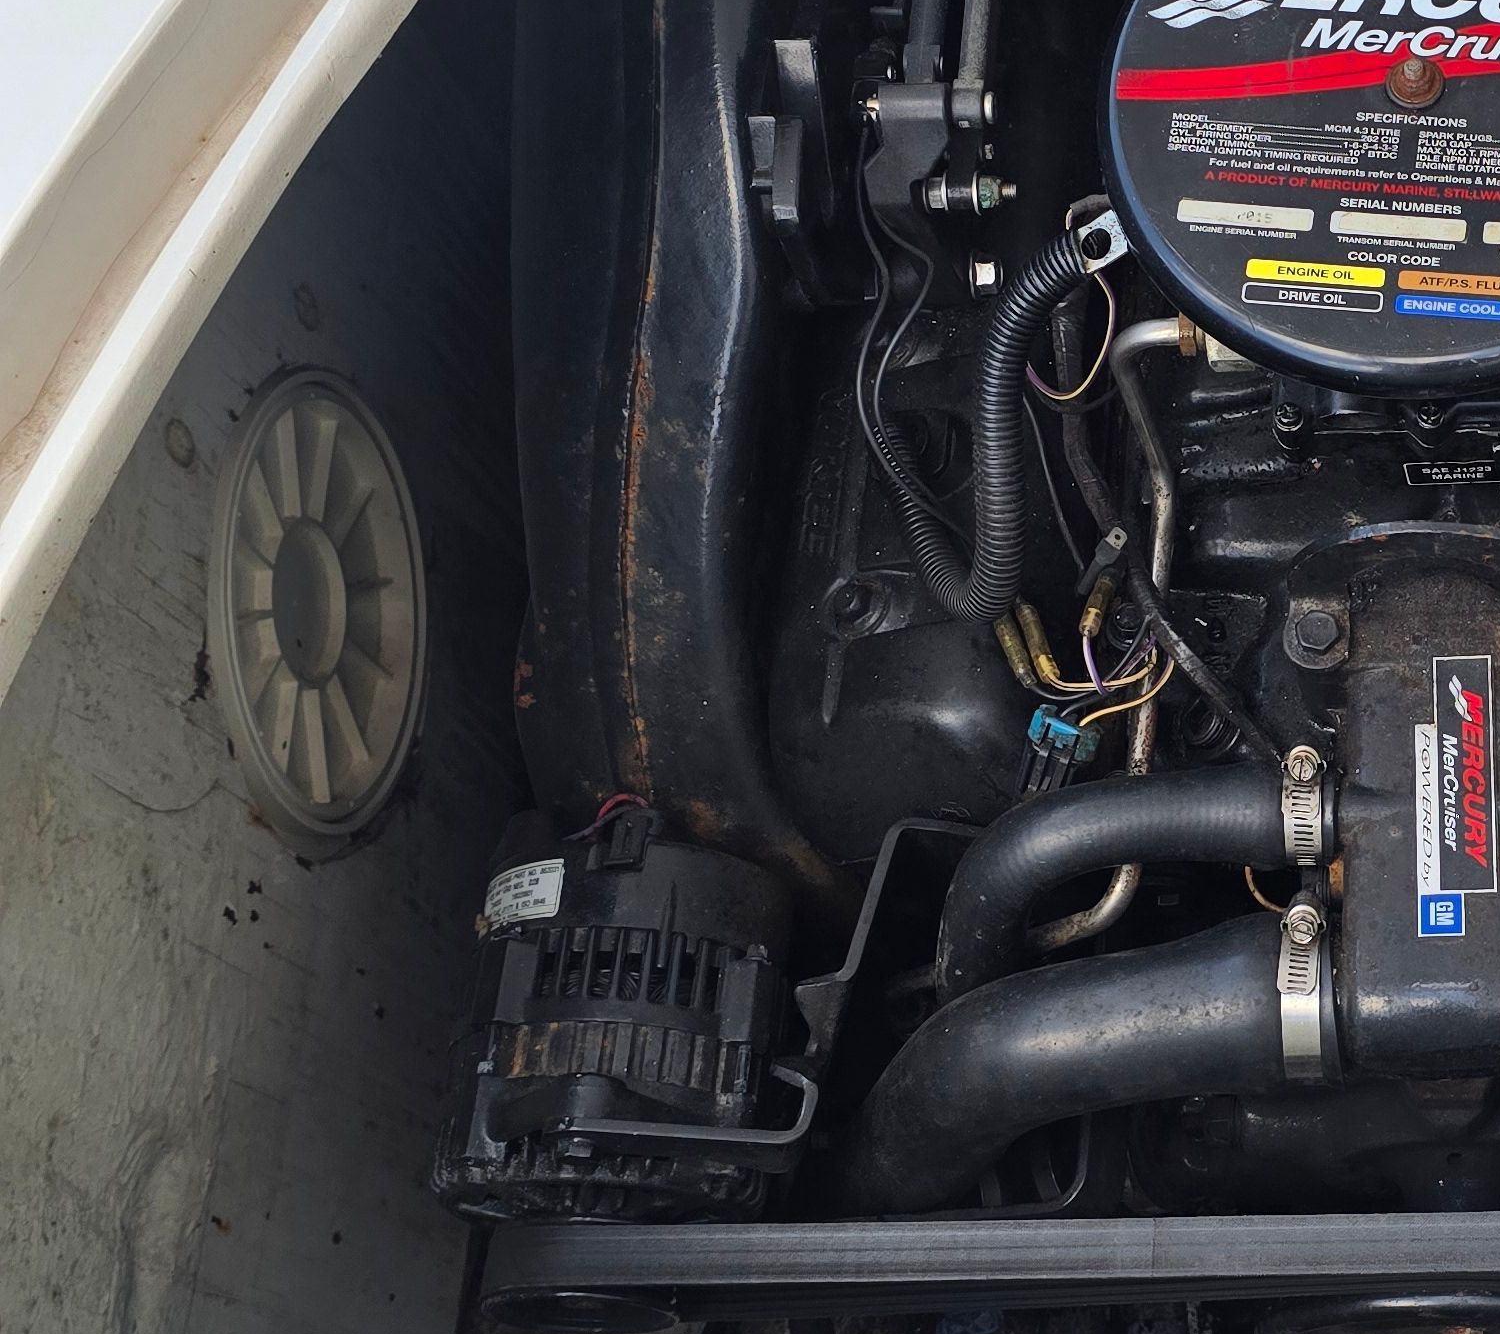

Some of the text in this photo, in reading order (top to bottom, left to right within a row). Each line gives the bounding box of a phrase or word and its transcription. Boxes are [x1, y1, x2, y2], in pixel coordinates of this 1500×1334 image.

[1173, 113, 1400, 136] MODEL MCM 4.3 LITRE
[1356, 112, 1467, 127] SPECIFICATIONS
[1171, 121, 1253, 133] DISPLACEMENT
[1381, 136, 1399, 144] CID
[1197, 130, 1230, 139] FIRING
[1233, 133, 1272, 142] ORDER
[1419, 131, 1453, 140] SPARK
[1456, 133, 1492, 142] PLUGS
[1169, 136, 1218, 146] IGNITION
[1220, 140, 1255, 148] TIMING
[1368, 151, 1398, 159] BTDC
[1418, 139, 1447, 148] PLUG
[1418, 146, 1443, 155] MAX.
[1168, 144, 1358, 164] SPECIAL IGNITION TIMING REQUIRED
[1416, 154, 1440, 162] IDLE
[1443, 155, 1467, 164] RPM
[1469, 157, 1483, 165] IN
[1209, 158, 1228, 167] For
[1230, 159, 1251, 168] fuel
[1254, 161, 1274, 170] and
[1277, 164, 1290, 172] oil
[1292, 165, 1365, 178] requirements
[1368, 170, 1395, 179] refer
[1398, 172, 1408, 180] to
[1411, 173, 1472, 185] Operations
[1475, 177, 1483, 185] &
[1416, 162, 1455, 171] ENGINE
[1205, 171, 1215, 180] A
[1218, 172, 1285, 186] PRODUCT
[1289, 177, 1308, 187] OF
[1311, 180, 1380, 192] MERCURY
[1383, 184, 1440, 197] MARINE,
[1340, 198, 1462, 214] SERIAL NUMBERS
[1189, 225, 1297, 239] ENGINE SERIAL NUMBER
[1337, 236, 1456, 251] TRANSOM SERIAL NUMBER
[1348, 251, 1440, 267] COLOR CODE
[1278, 266, 1355, 280] ENGINE OIL
[1419, 276, 1471, 288] ATF/P.S.
[1279, 291, 1346, 304] DRIVE OIL
[1403, 300, 1456, 312] ENGINE
[1461, 689, 1487, 868] MERCURY
[1442, 733, 1457, 851] MerCruiser
[1420, 731, 1432, 888] POWERED by
[1436, 900, 1454, 926] GM
